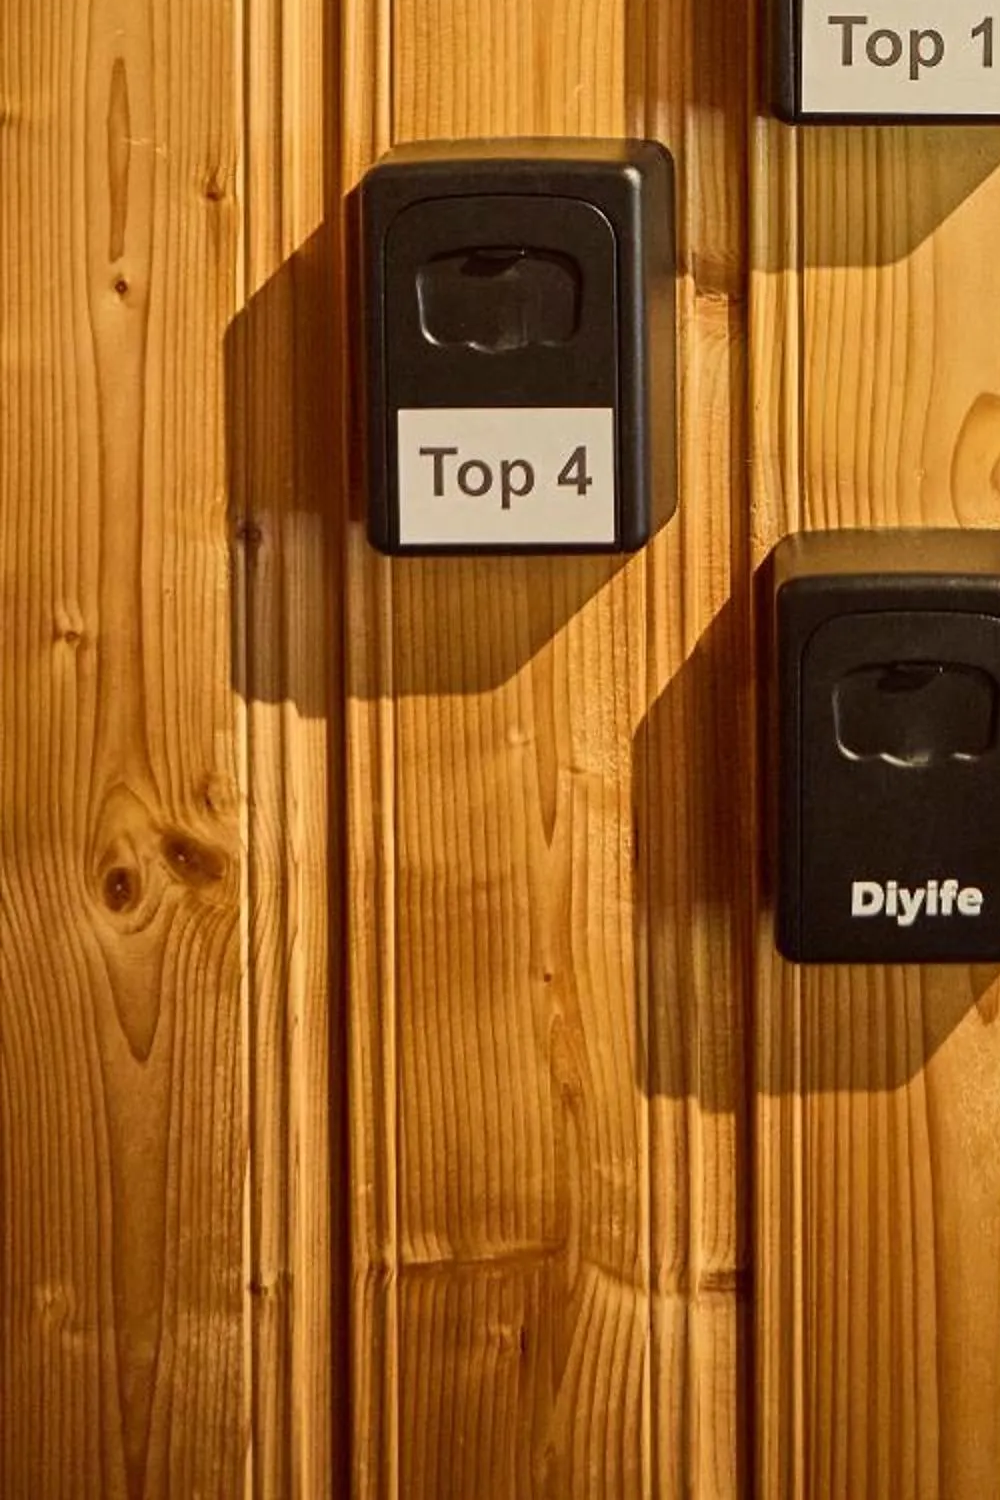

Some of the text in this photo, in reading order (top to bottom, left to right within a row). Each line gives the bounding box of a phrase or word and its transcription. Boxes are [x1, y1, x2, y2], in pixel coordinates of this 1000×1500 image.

[828, 15, 994, 81] Top 1
[419, 446, 594, 510] Top 4
[850, 879, 984, 926] Diyife
